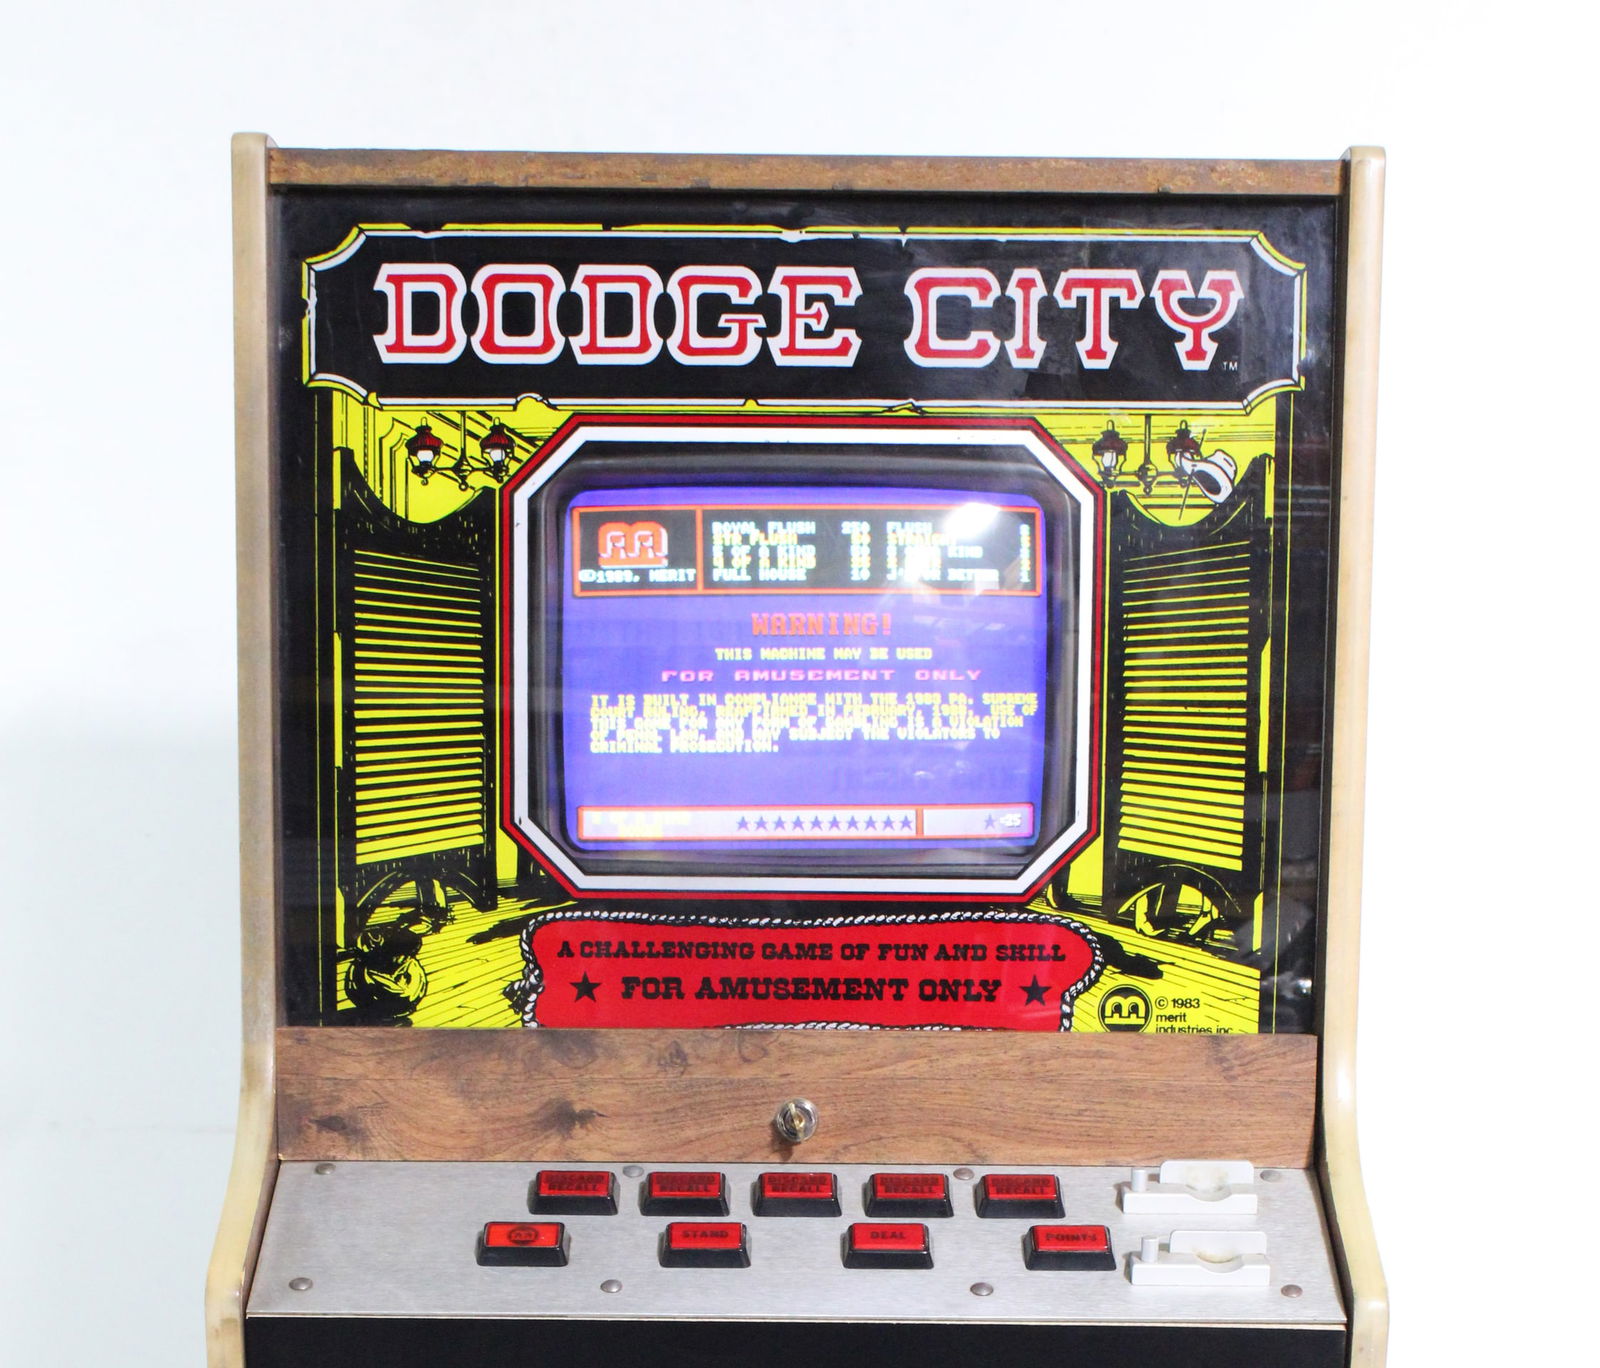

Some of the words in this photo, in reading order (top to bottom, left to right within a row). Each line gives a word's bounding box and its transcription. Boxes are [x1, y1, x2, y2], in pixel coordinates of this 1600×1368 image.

[374, 263, 862, 366] DODGE
[904, 267, 1245, 371] CITY
[1223, 361, 1238, 371] TM
[649, 569, 697, 582] MERIT
[751, 612, 892, 636] WARNING!
[715, 648, 753, 660] THIS
[760, 648, 826, 660] MACHINE
[834, 648, 862, 660] MAY
[869, 648, 889, 660] BE
[896, 648, 933, 660] USED
[661, 670, 714, 682] FOR
[734, 670, 895, 682] AMUSEMENT
[914, 669, 982, 681] ONLY
[557, 940, 575, 958] A
[580, 940, 755, 960] CHALLENGING
[761, 942, 833, 961] GAME
[840, 943, 870, 961] OF
[877, 943, 929, 961] FUN
[934, 943, 987, 961] AND
[995, 944, 1066, 962] SKILL
[621, 976, 685, 1000] FOR
[694, 976, 909, 1001] AMUSEMENT
[918, 978, 1002, 1002] ONLY
[1172, 998, 1200, 1009] 1983
[1156, 1012, 1187, 1023] merit
[869, 1231, 906, 1240] DEAL
